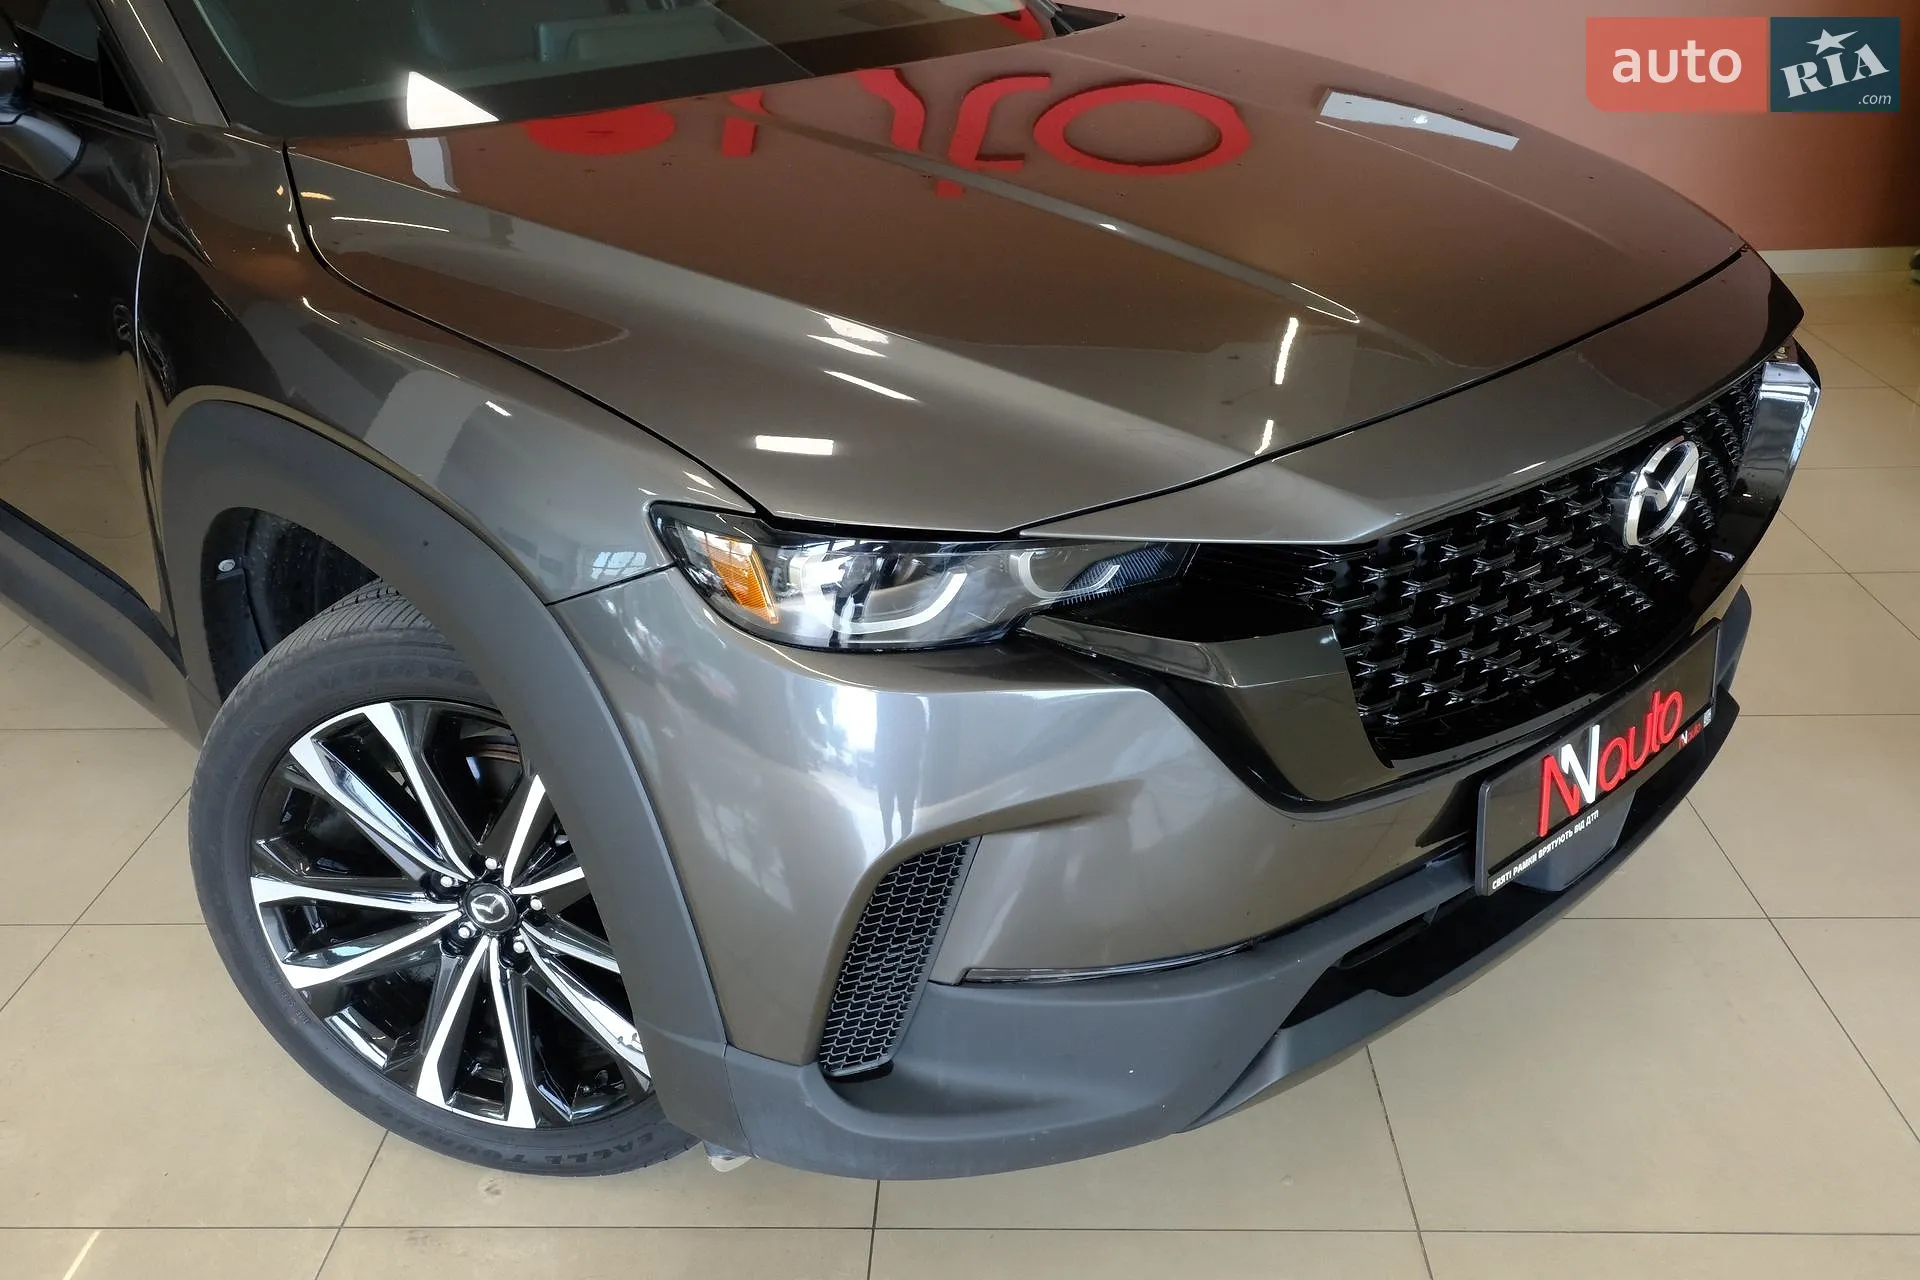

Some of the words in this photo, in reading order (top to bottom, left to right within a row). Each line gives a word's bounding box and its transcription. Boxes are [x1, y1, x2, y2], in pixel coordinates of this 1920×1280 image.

[1492, 870, 1512, 890] СВЯТІ
[1512, 853, 1538, 876] РАМКИ
[1538, 829, 1574, 858] ВРЯТУЮТЬ
[1574, 819, 1586, 834] ВІД
[1585, 810, 1599, 826] ДТП
